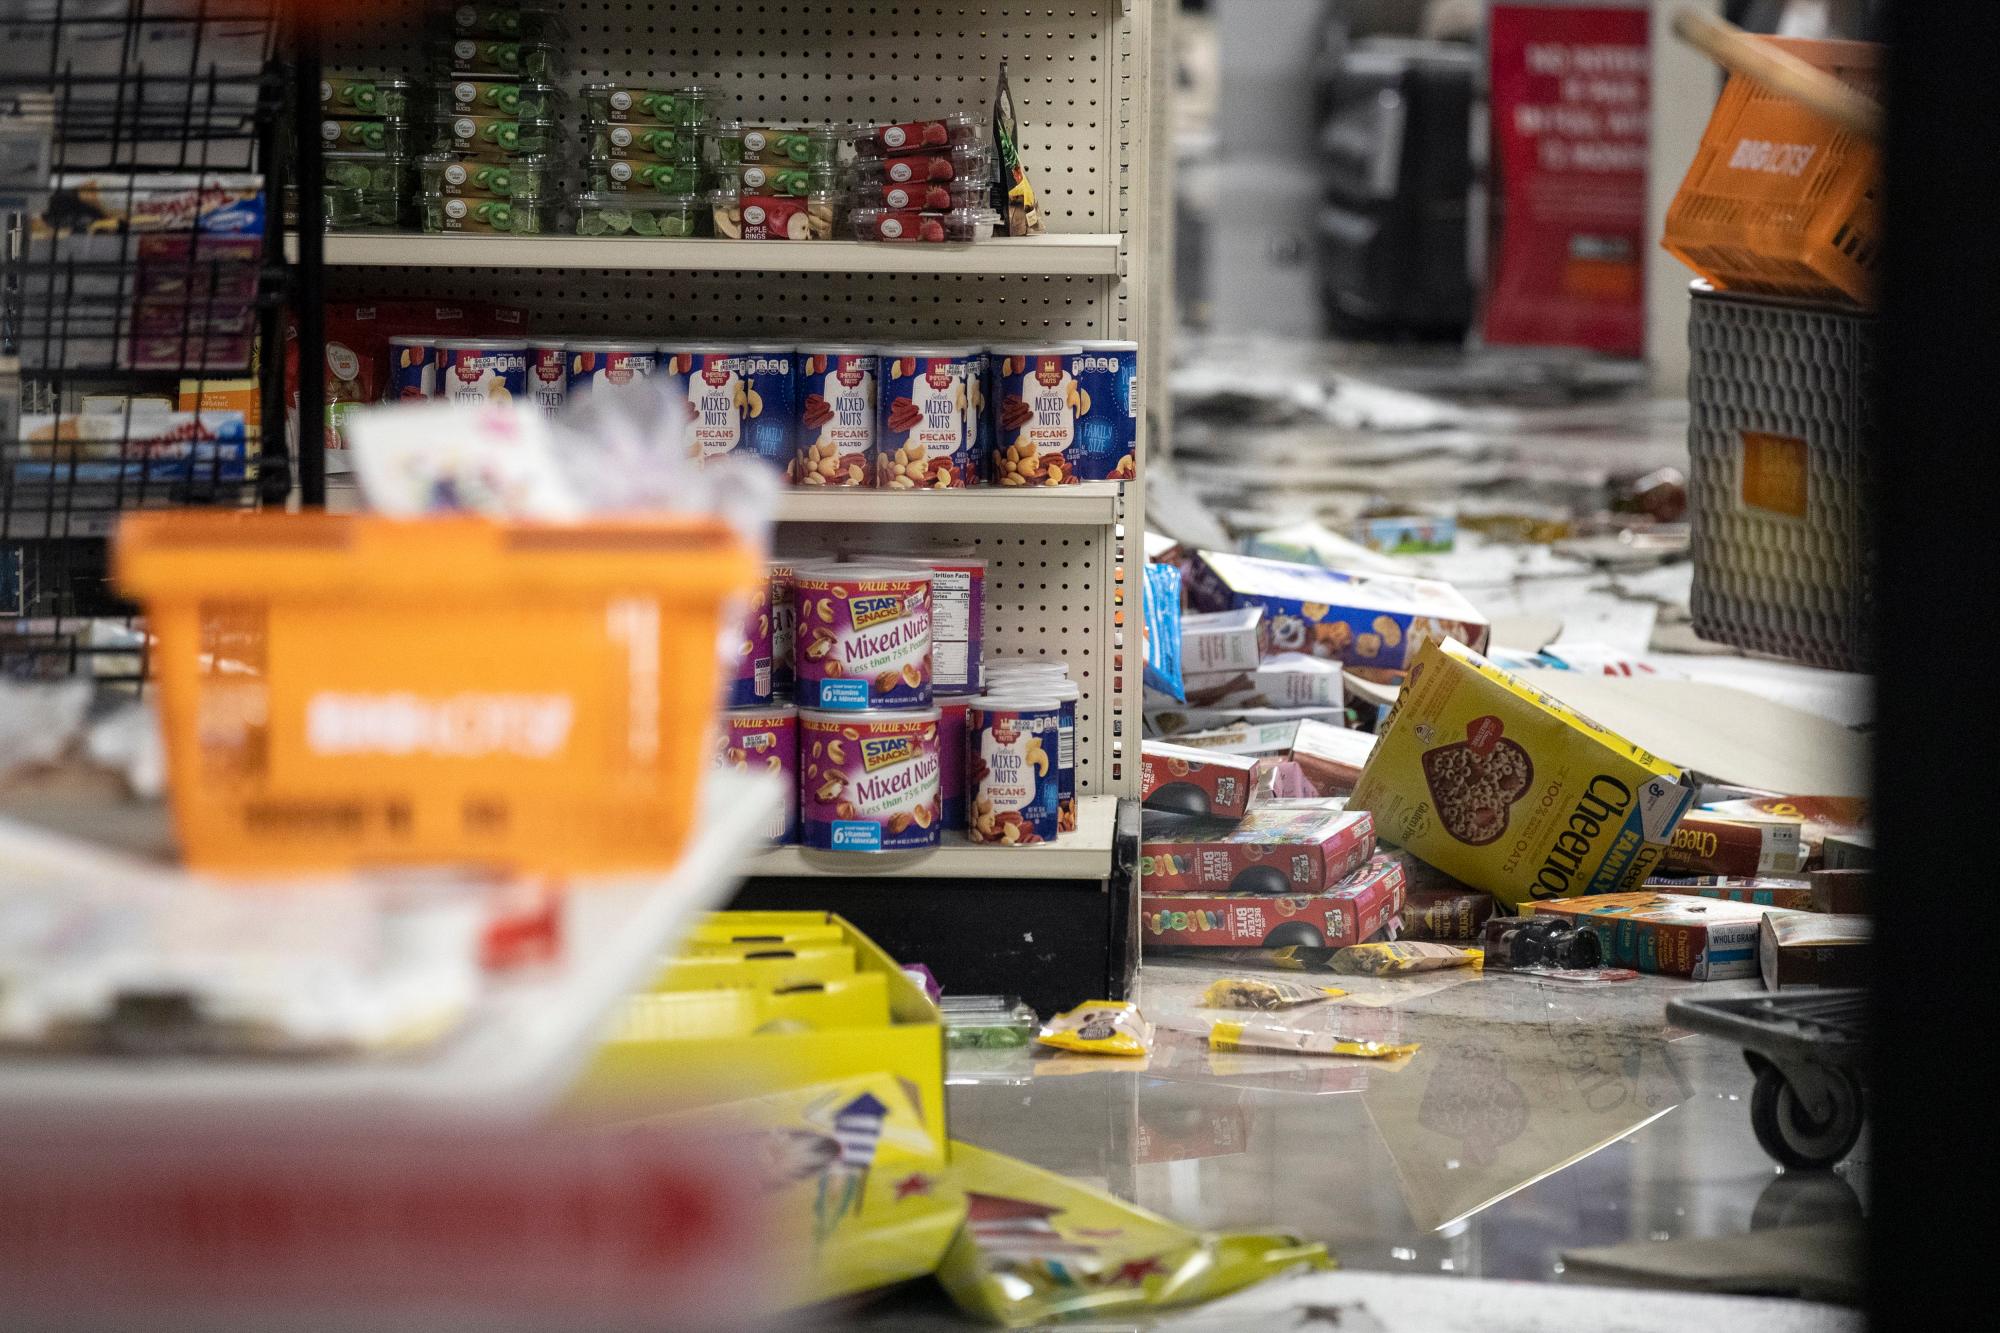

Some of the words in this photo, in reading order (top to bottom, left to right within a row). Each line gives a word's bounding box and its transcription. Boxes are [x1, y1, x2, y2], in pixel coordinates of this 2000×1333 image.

[535, 391, 563, 406] MIXED
[701, 396, 731, 411] MIXED
[836, 396, 865, 411] MIXED
[1035, 396, 1064, 412] MIXED
[925, 399, 953, 414] MIXED
[705, 411, 727, 426] NUTS
[840, 411, 862, 426] NUTS
[928, 414, 950, 429] NUTS
[1039, 412, 1061, 426] NUTS
[696, 430, 734, 438] PECANS
[831, 430, 870, 438] PECANS
[920, 433, 957, 441] PECANS
[1030, 430, 1068, 438] PECANS
[1083, 422, 1113, 440] FAMILY
[1088, 438, 1105, 453] SIZE
[858, 581, 890, 591] VALUE
[891, 581, 912, 590] SIZE
[853, 597, 897, 615] STAR
[856, 608, 899, 625] SNACKS
[844, 626, 900, 663] Mixed
[903, 613, 929, 642] Nuts
[870, 654, 891, 669] than
[822, 685, 834, 702] 6
[733, 718, 765, 729] VALUE
[766, 717, 785, 727] SIZE
[821, 723, 841, 732] SIZE
[869, 723, 900, 733] VALUE
[902, 722, 921, 731] SIZE
[865, 738, 908, 757] STAR
[868, 749, 910, 767] SNACKS
[991, 753, 1022, 769] MIXED
[856, 767, 912, 805] Mixed
[914, 752, 938, 783] Nuts
[995, 769, 1018, 783] NUTS
[1143, 762, 1153, 783] BEST
[987, 787, 1026, 796] PECANS
[1142, 784, 1151, 793] IN
[882, 796, 902, 810] than
[1538, 778, 1563, 819] 100%
[834, 827, 845, 844] 6
[1528, 774, 1632, 900] Cheerios
[1503, 840, 1530, 875] OATS
[1202, 851, 1215, 881] BITE
[1213, 851, 1222, 881] EVERY
[1222, 873, 1230, 881] IN
[1235, 907, 1249, 938] BITE
[1247, 907, 1256, 937] EVERY
[1254, 907, 1262, 928] BEST
[1324, 911, 1335, 937] LOOPS
[1332, 909, 1344, 938] FROOT
[1255, 928, 1263, 938] IN
[1712, 934, 1736, 944] WHOLE
[1736, 933, 1757, 943] GRAIN
